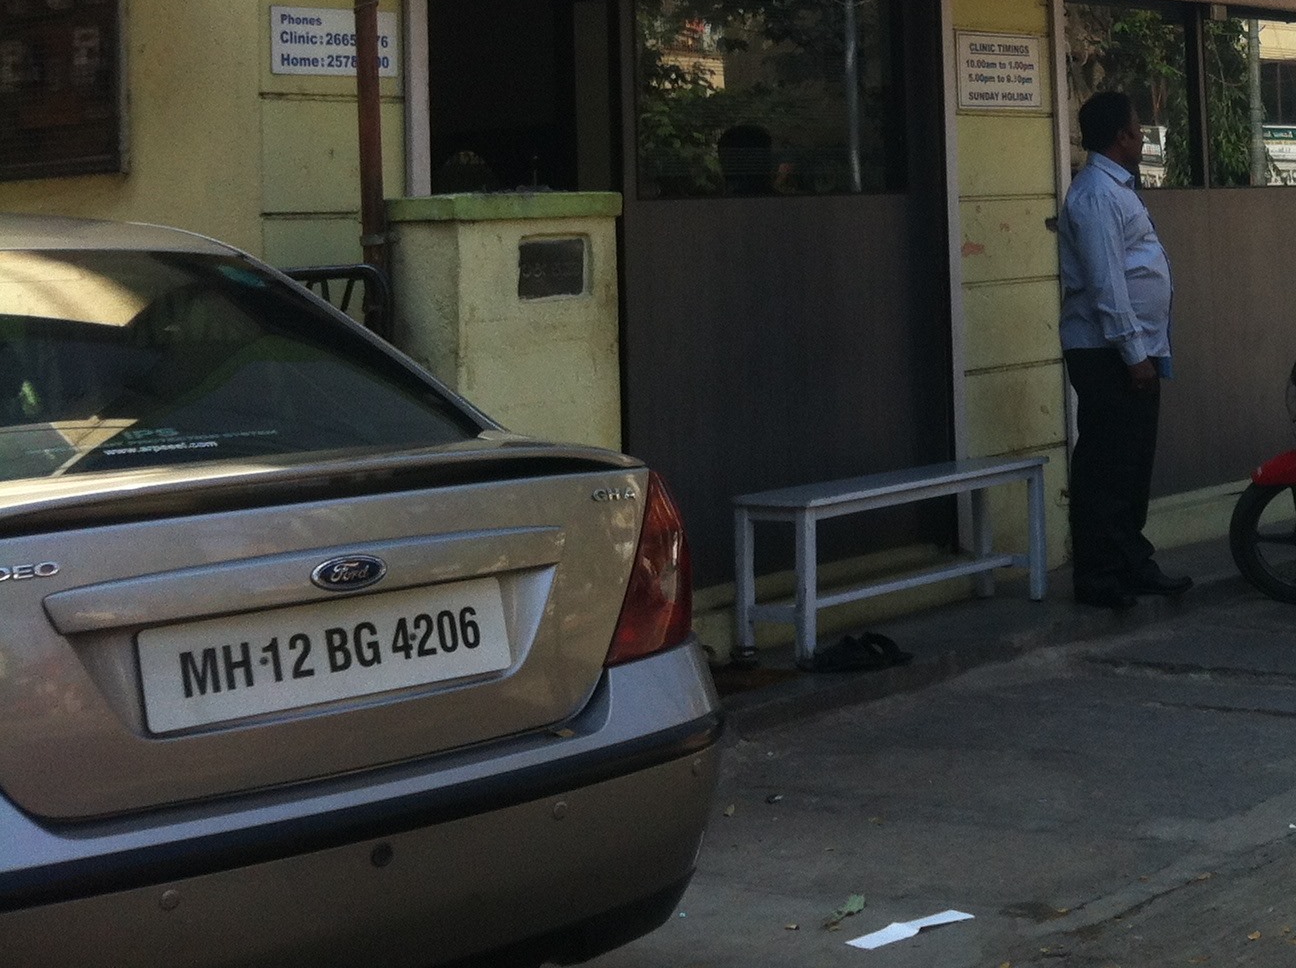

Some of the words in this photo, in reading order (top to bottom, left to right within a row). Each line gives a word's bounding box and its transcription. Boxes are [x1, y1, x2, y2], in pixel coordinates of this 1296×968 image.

[280, 13, 323, 27] Phones
[969, 42, 996, 53] CLINIC
[997, 44, 1031, 55] TIMINGS
[968, 91, 1000, 102] SUNDAY
[1001, 92, 1034, 102] HOLIDAY
[325, 621, 382, 673] BG
[392, 606, 481, 660] 4206
